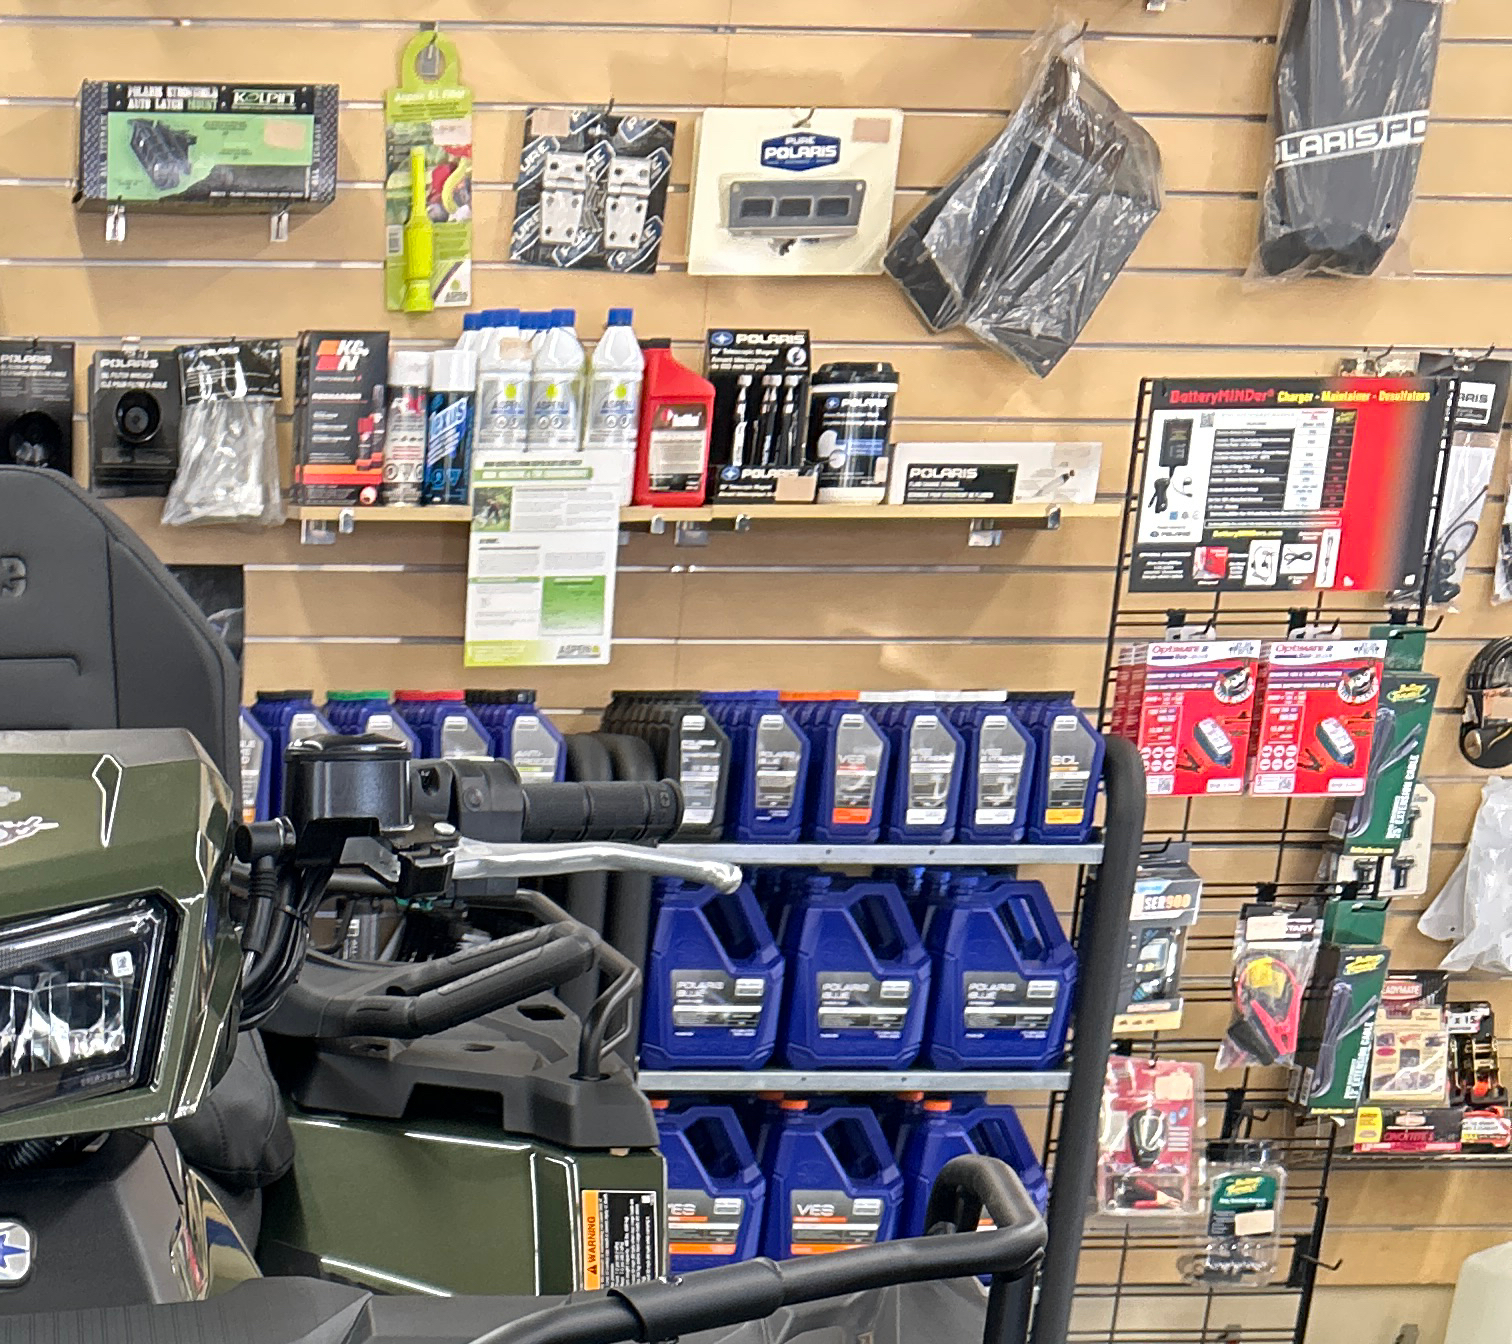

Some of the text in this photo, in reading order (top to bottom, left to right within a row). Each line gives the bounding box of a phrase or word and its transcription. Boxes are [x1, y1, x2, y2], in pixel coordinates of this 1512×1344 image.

[233, 89, 295, 106] KOLPIN
[1275, 124, 1380, 164] LARIS
[764, 145, 838, 160] POLARIS
[736, 333, 806, 345] POLARIS
[0, 354, 52, 365] POLARIS
[100, 358, 159, 370] POLARIS
[909, 467, 978, 480] POLARIS
[668, 1203, 697, 1216] ES
[796, 1203, 836, 1217] VES
[587, 1216, 597, 1263] WARNING
